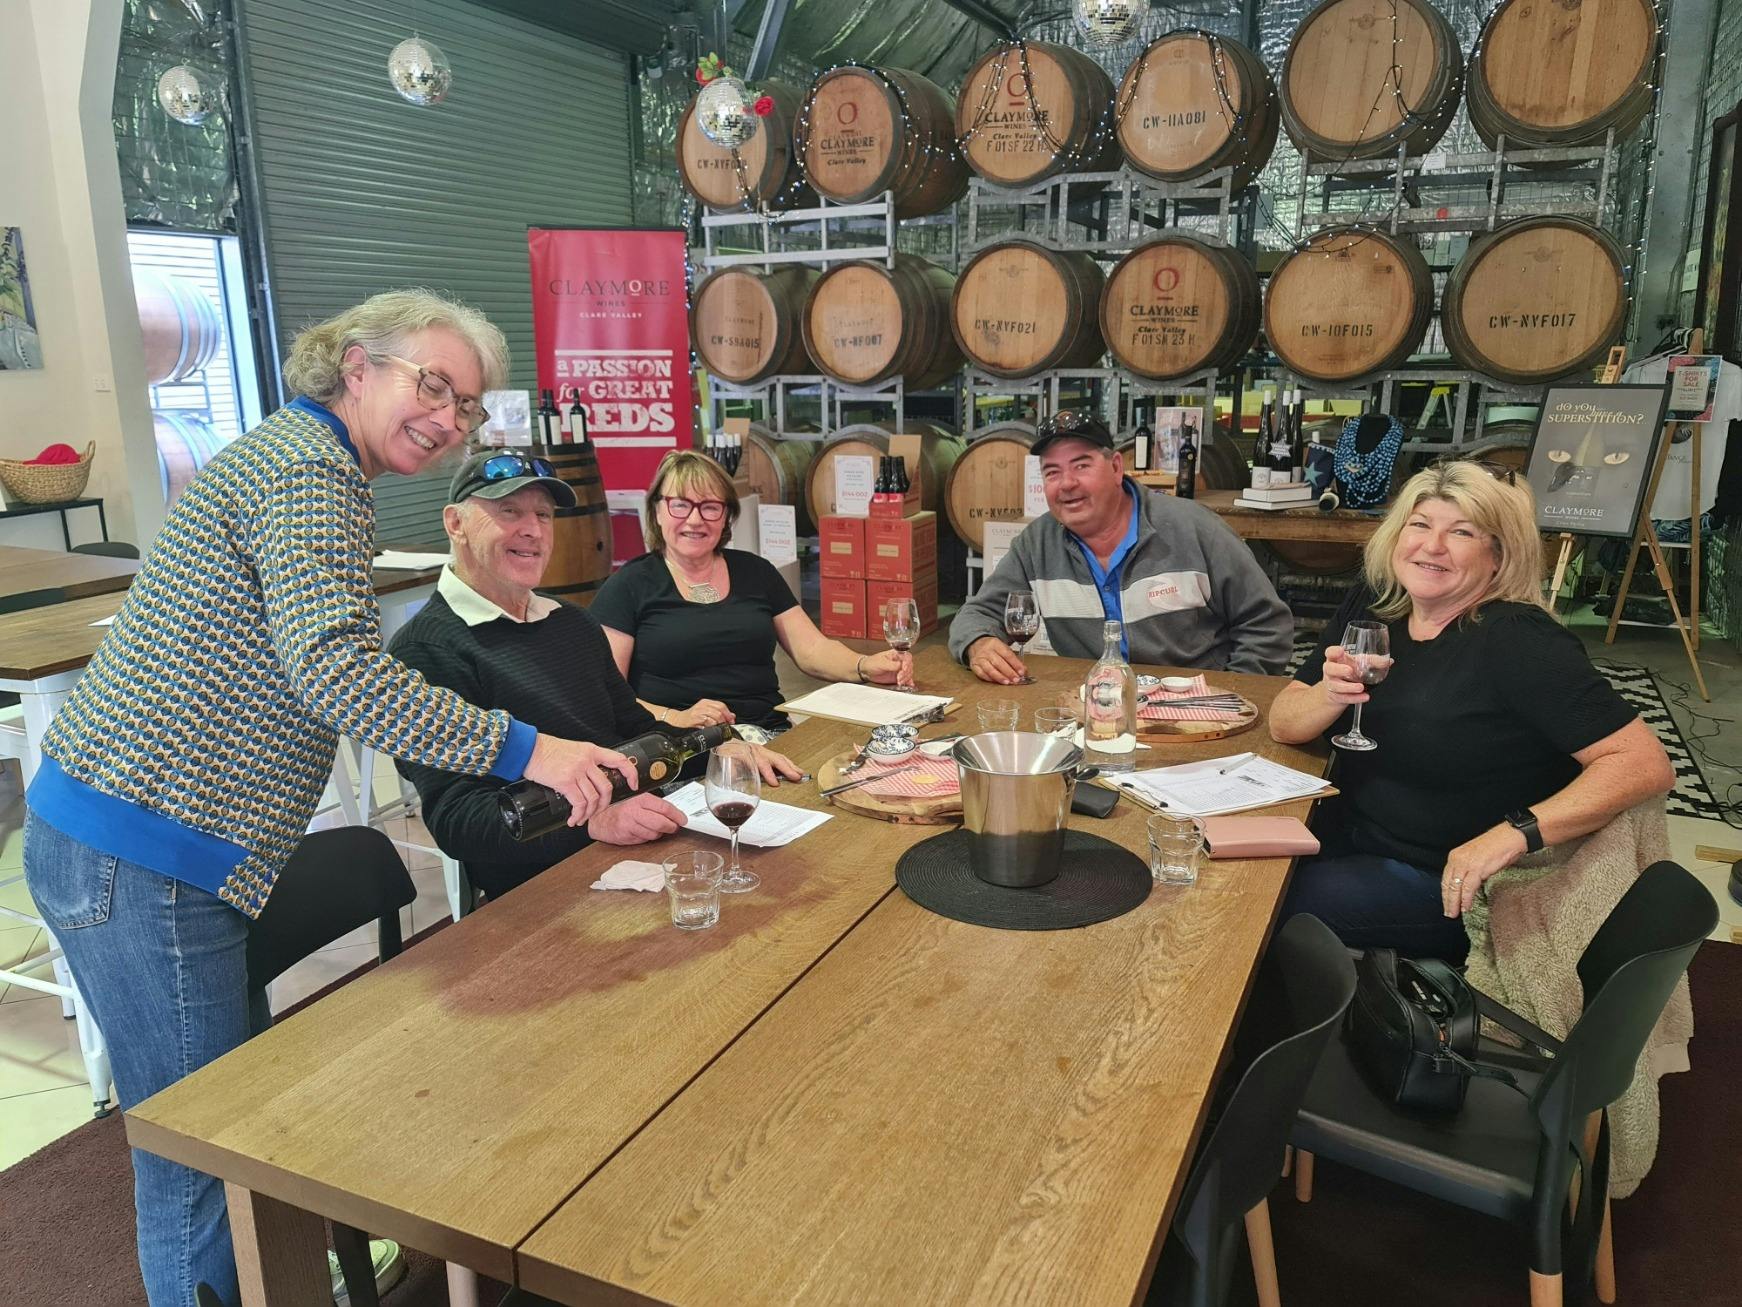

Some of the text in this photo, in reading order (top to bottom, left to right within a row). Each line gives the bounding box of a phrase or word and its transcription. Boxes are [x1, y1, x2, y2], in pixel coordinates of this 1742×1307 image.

[549, 279, 671, 296] CLAYMORE
[1130, 304, 1199, 316] CLAYMORE
[572, 359, 672, 377] PASSION
[588, 380, 673, 399] GREAT
[559, 402, 676, 432] REDS
[1544, 505, 1605, 517] CLAYMORE
